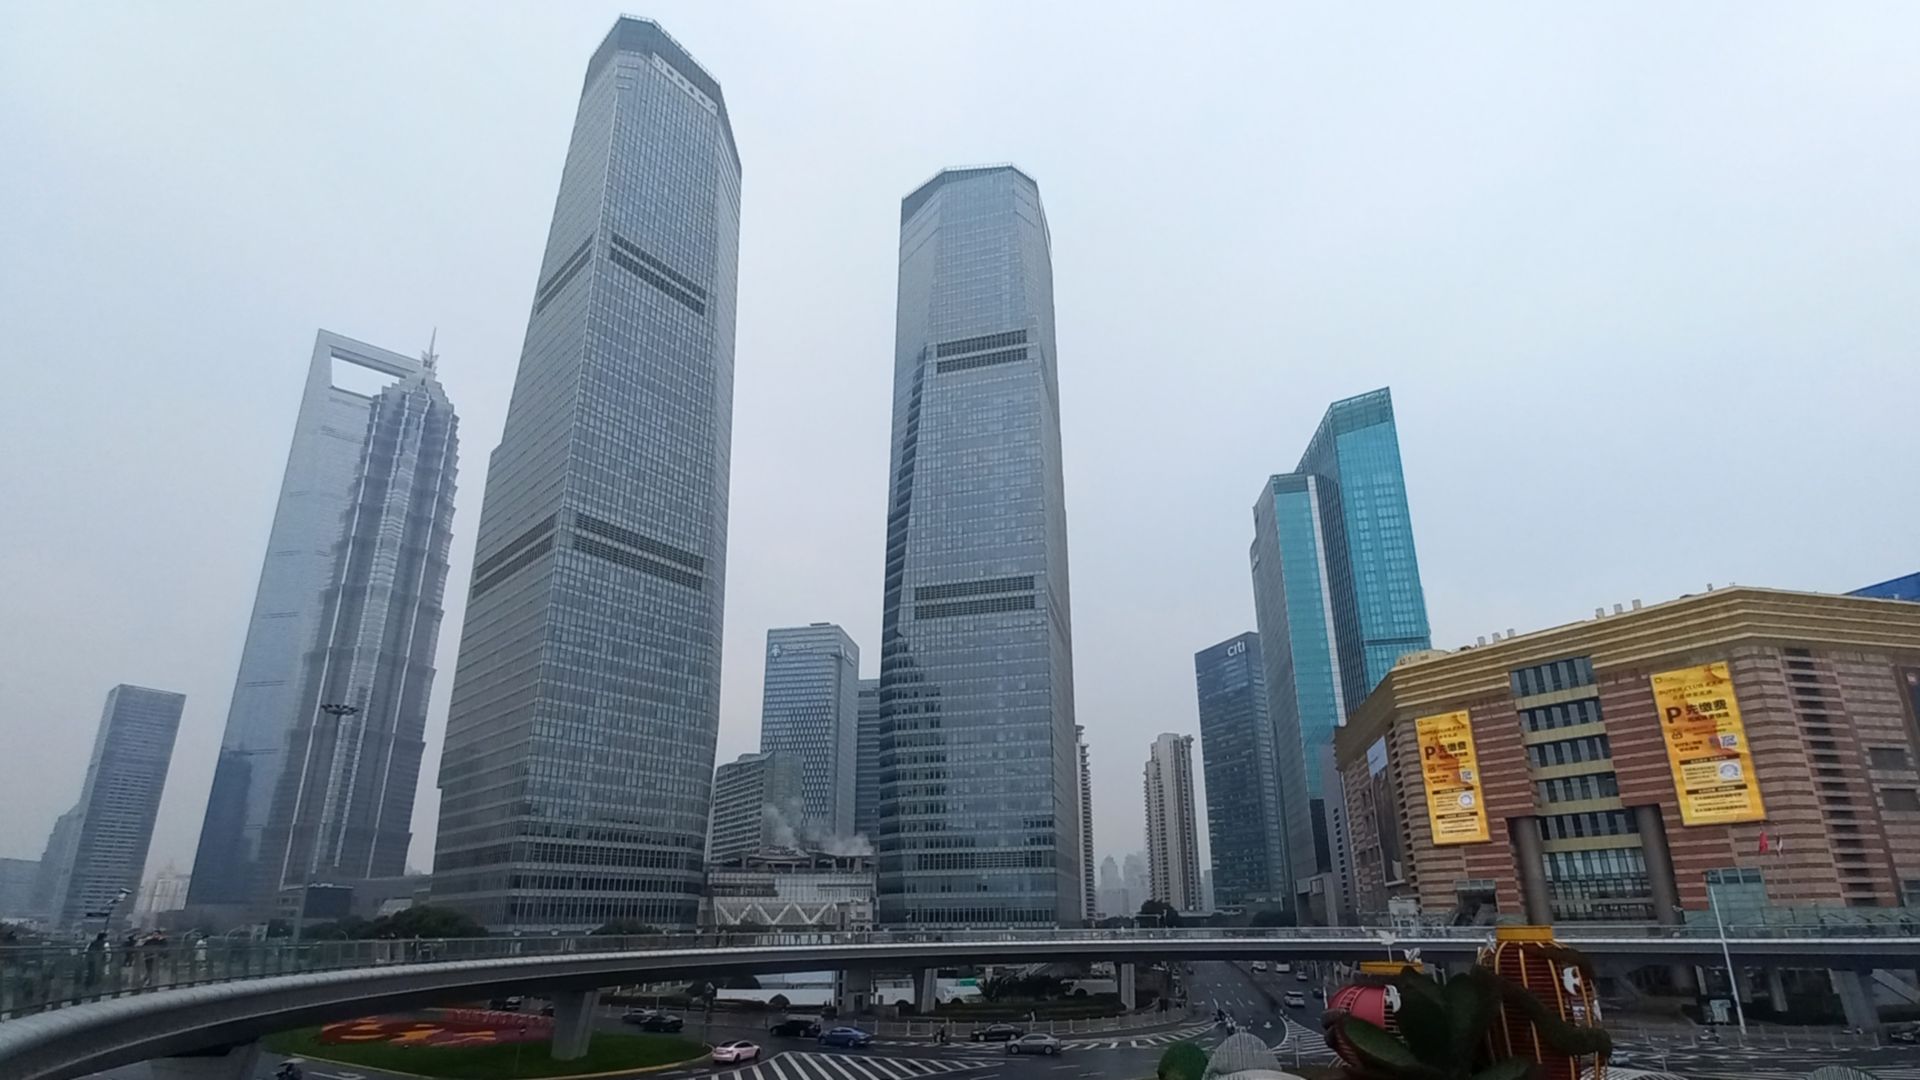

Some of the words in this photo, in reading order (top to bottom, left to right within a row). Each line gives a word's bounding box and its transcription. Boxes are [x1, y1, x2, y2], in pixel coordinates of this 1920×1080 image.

[1227, 641, 1246, 657] citi
[1666, 706, 1682, 724] P
[1425, 746, 1436, 760] P
